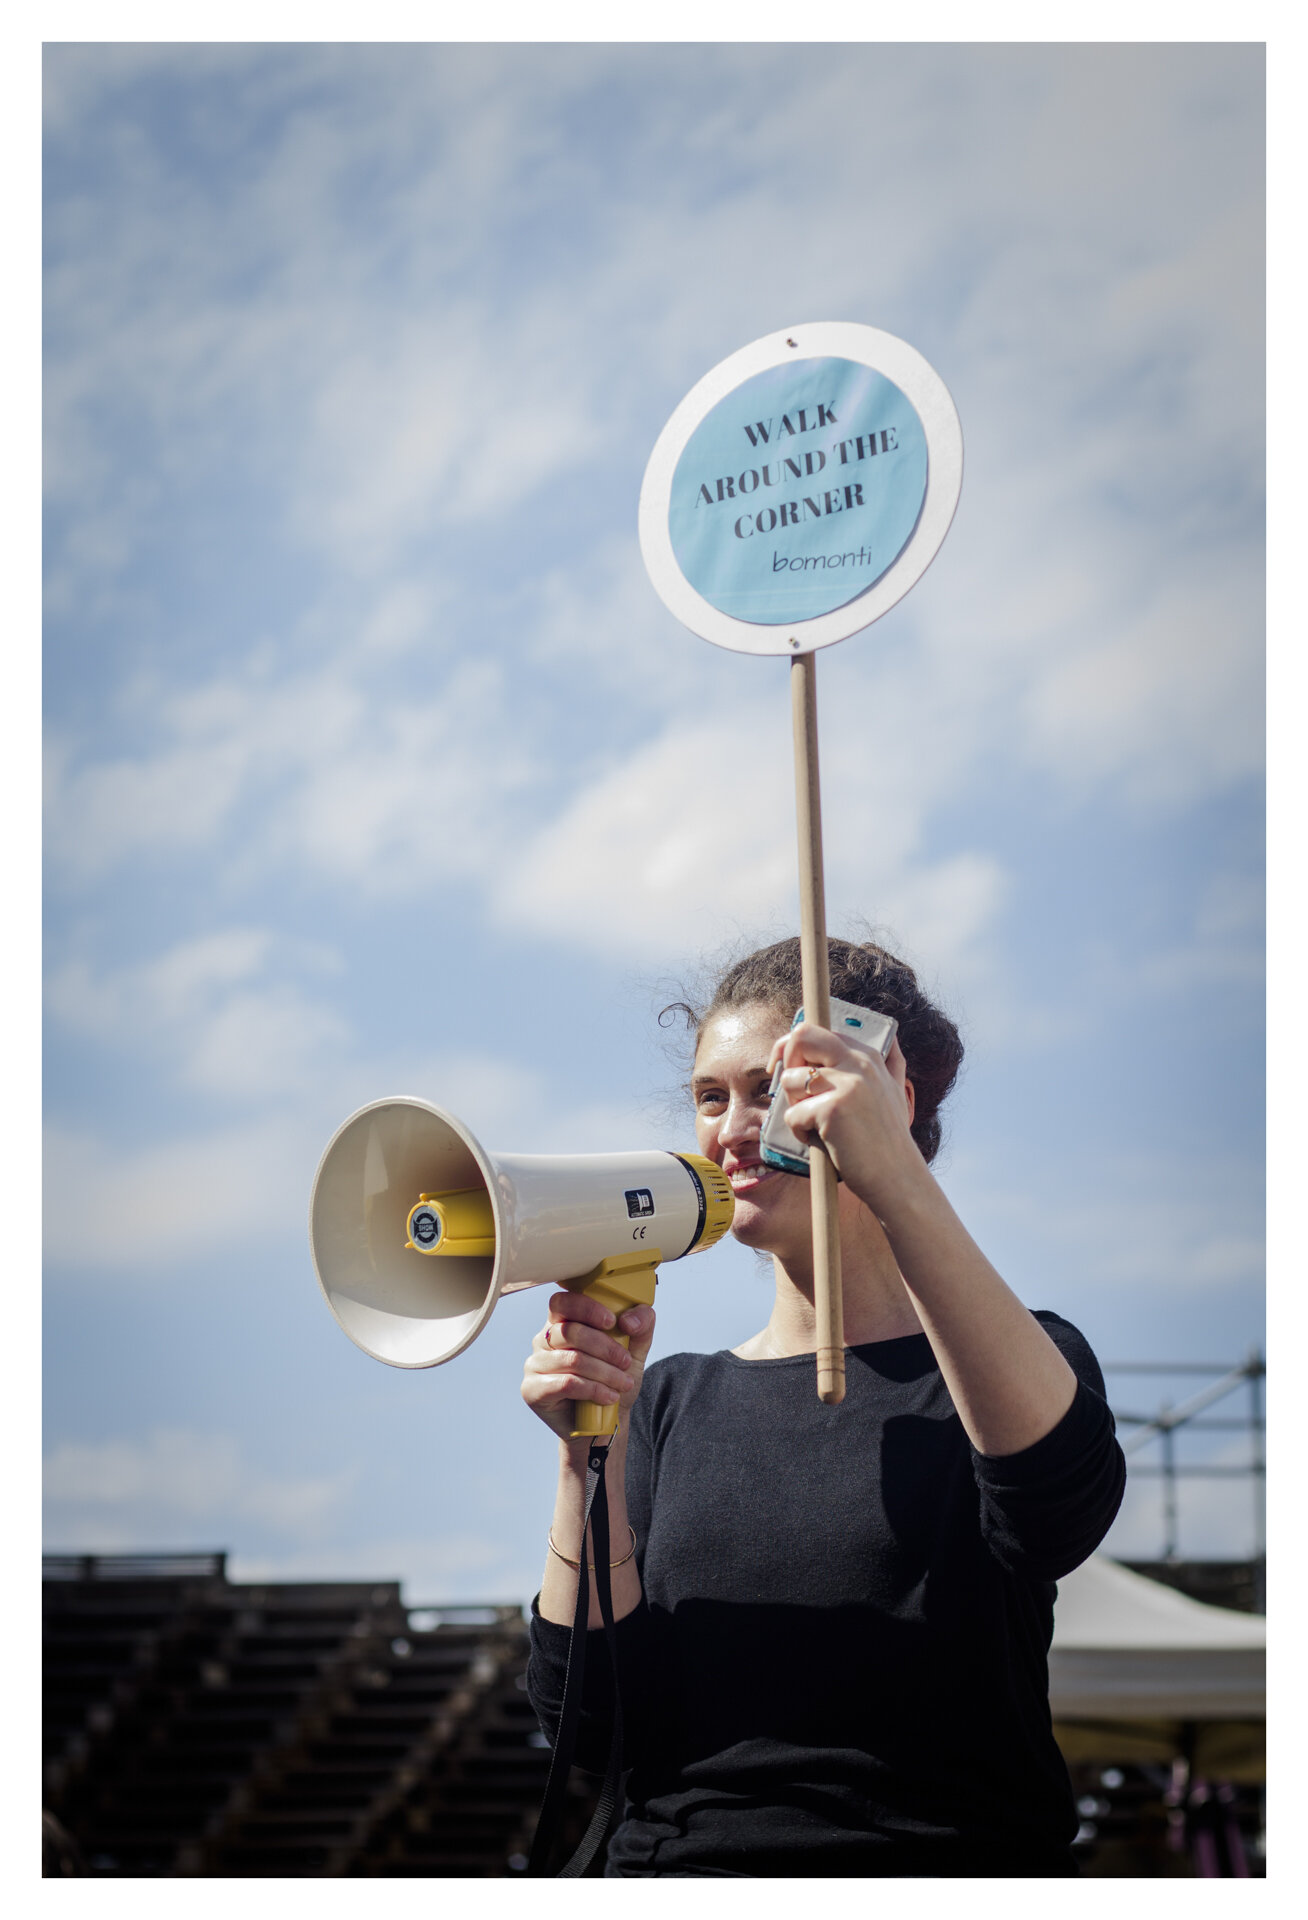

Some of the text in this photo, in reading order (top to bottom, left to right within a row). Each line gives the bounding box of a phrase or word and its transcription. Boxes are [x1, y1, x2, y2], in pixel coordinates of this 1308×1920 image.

[743, 401, 838, 447] WALK
[695, 427, 899, 508] AROUND THE
[734, 483, 865, 539] CORNER
[772, 546, 872, 572] bomonti
